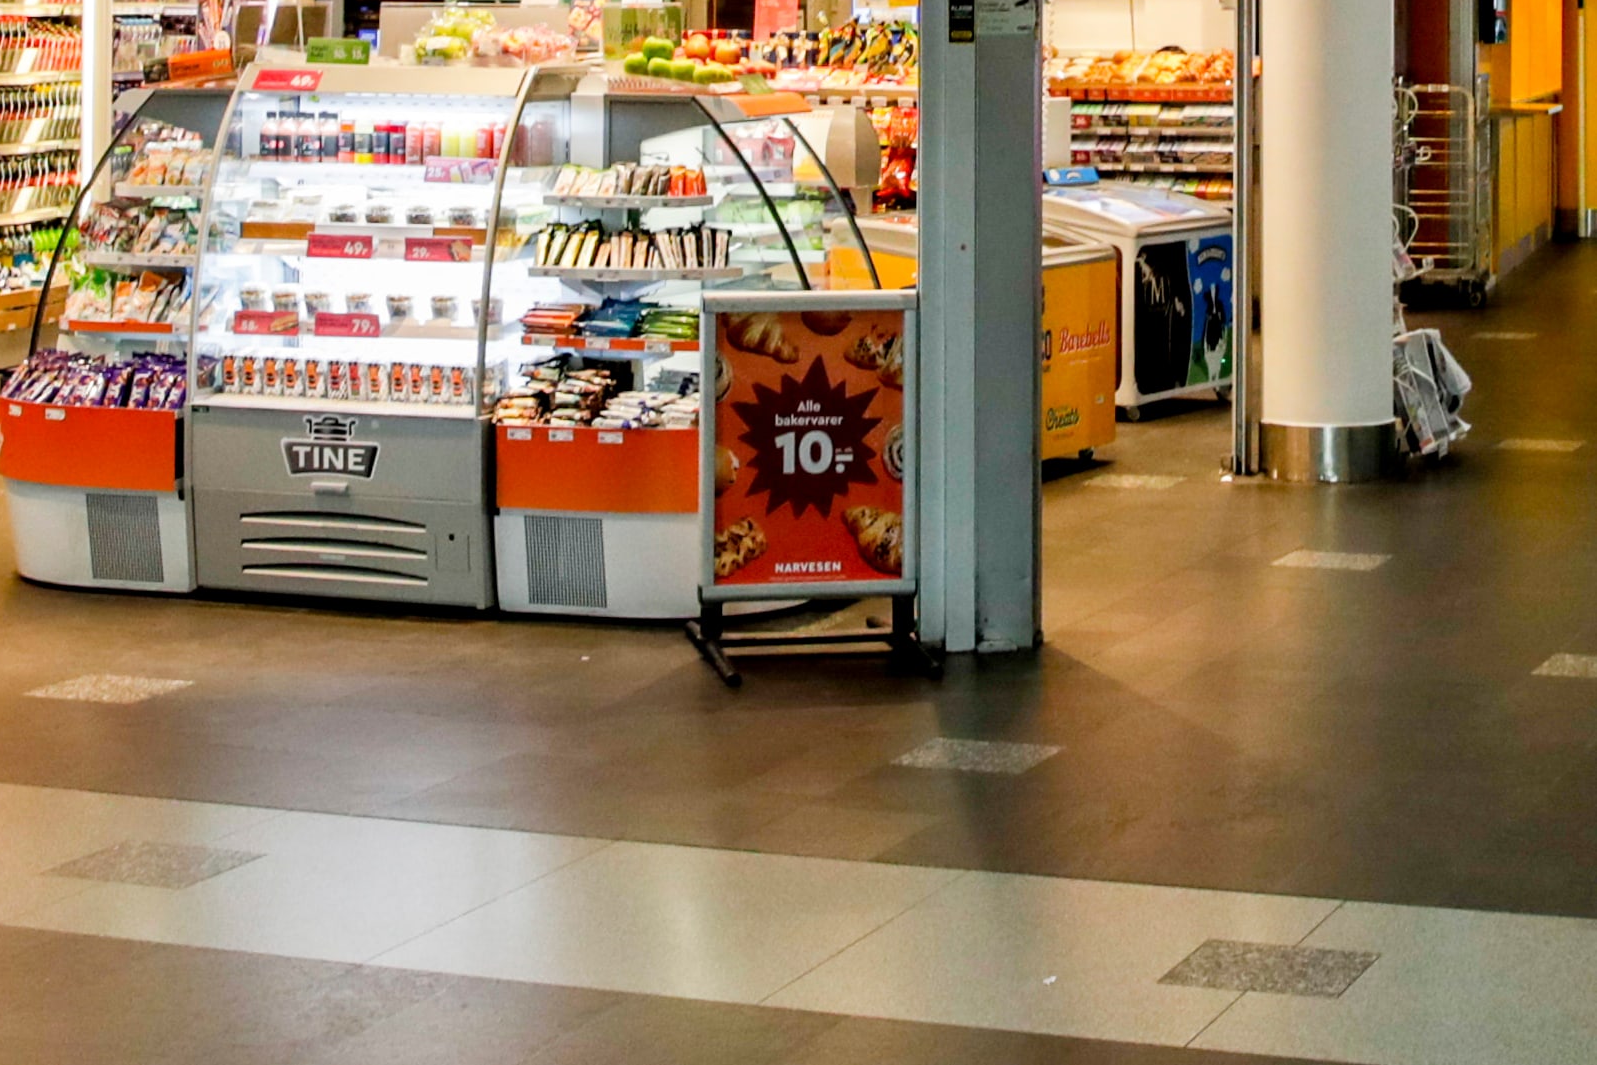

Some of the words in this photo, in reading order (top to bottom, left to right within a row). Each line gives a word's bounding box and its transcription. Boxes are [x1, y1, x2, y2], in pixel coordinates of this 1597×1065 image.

[1059, 321, 1111, 354] Barebells
[797, 400, 821, 412] Alle
[775, 413, 843, 426] bakervarer
[292, 445, 366, 471] TINE
[775, 561, 842, 573] NARVESEN
